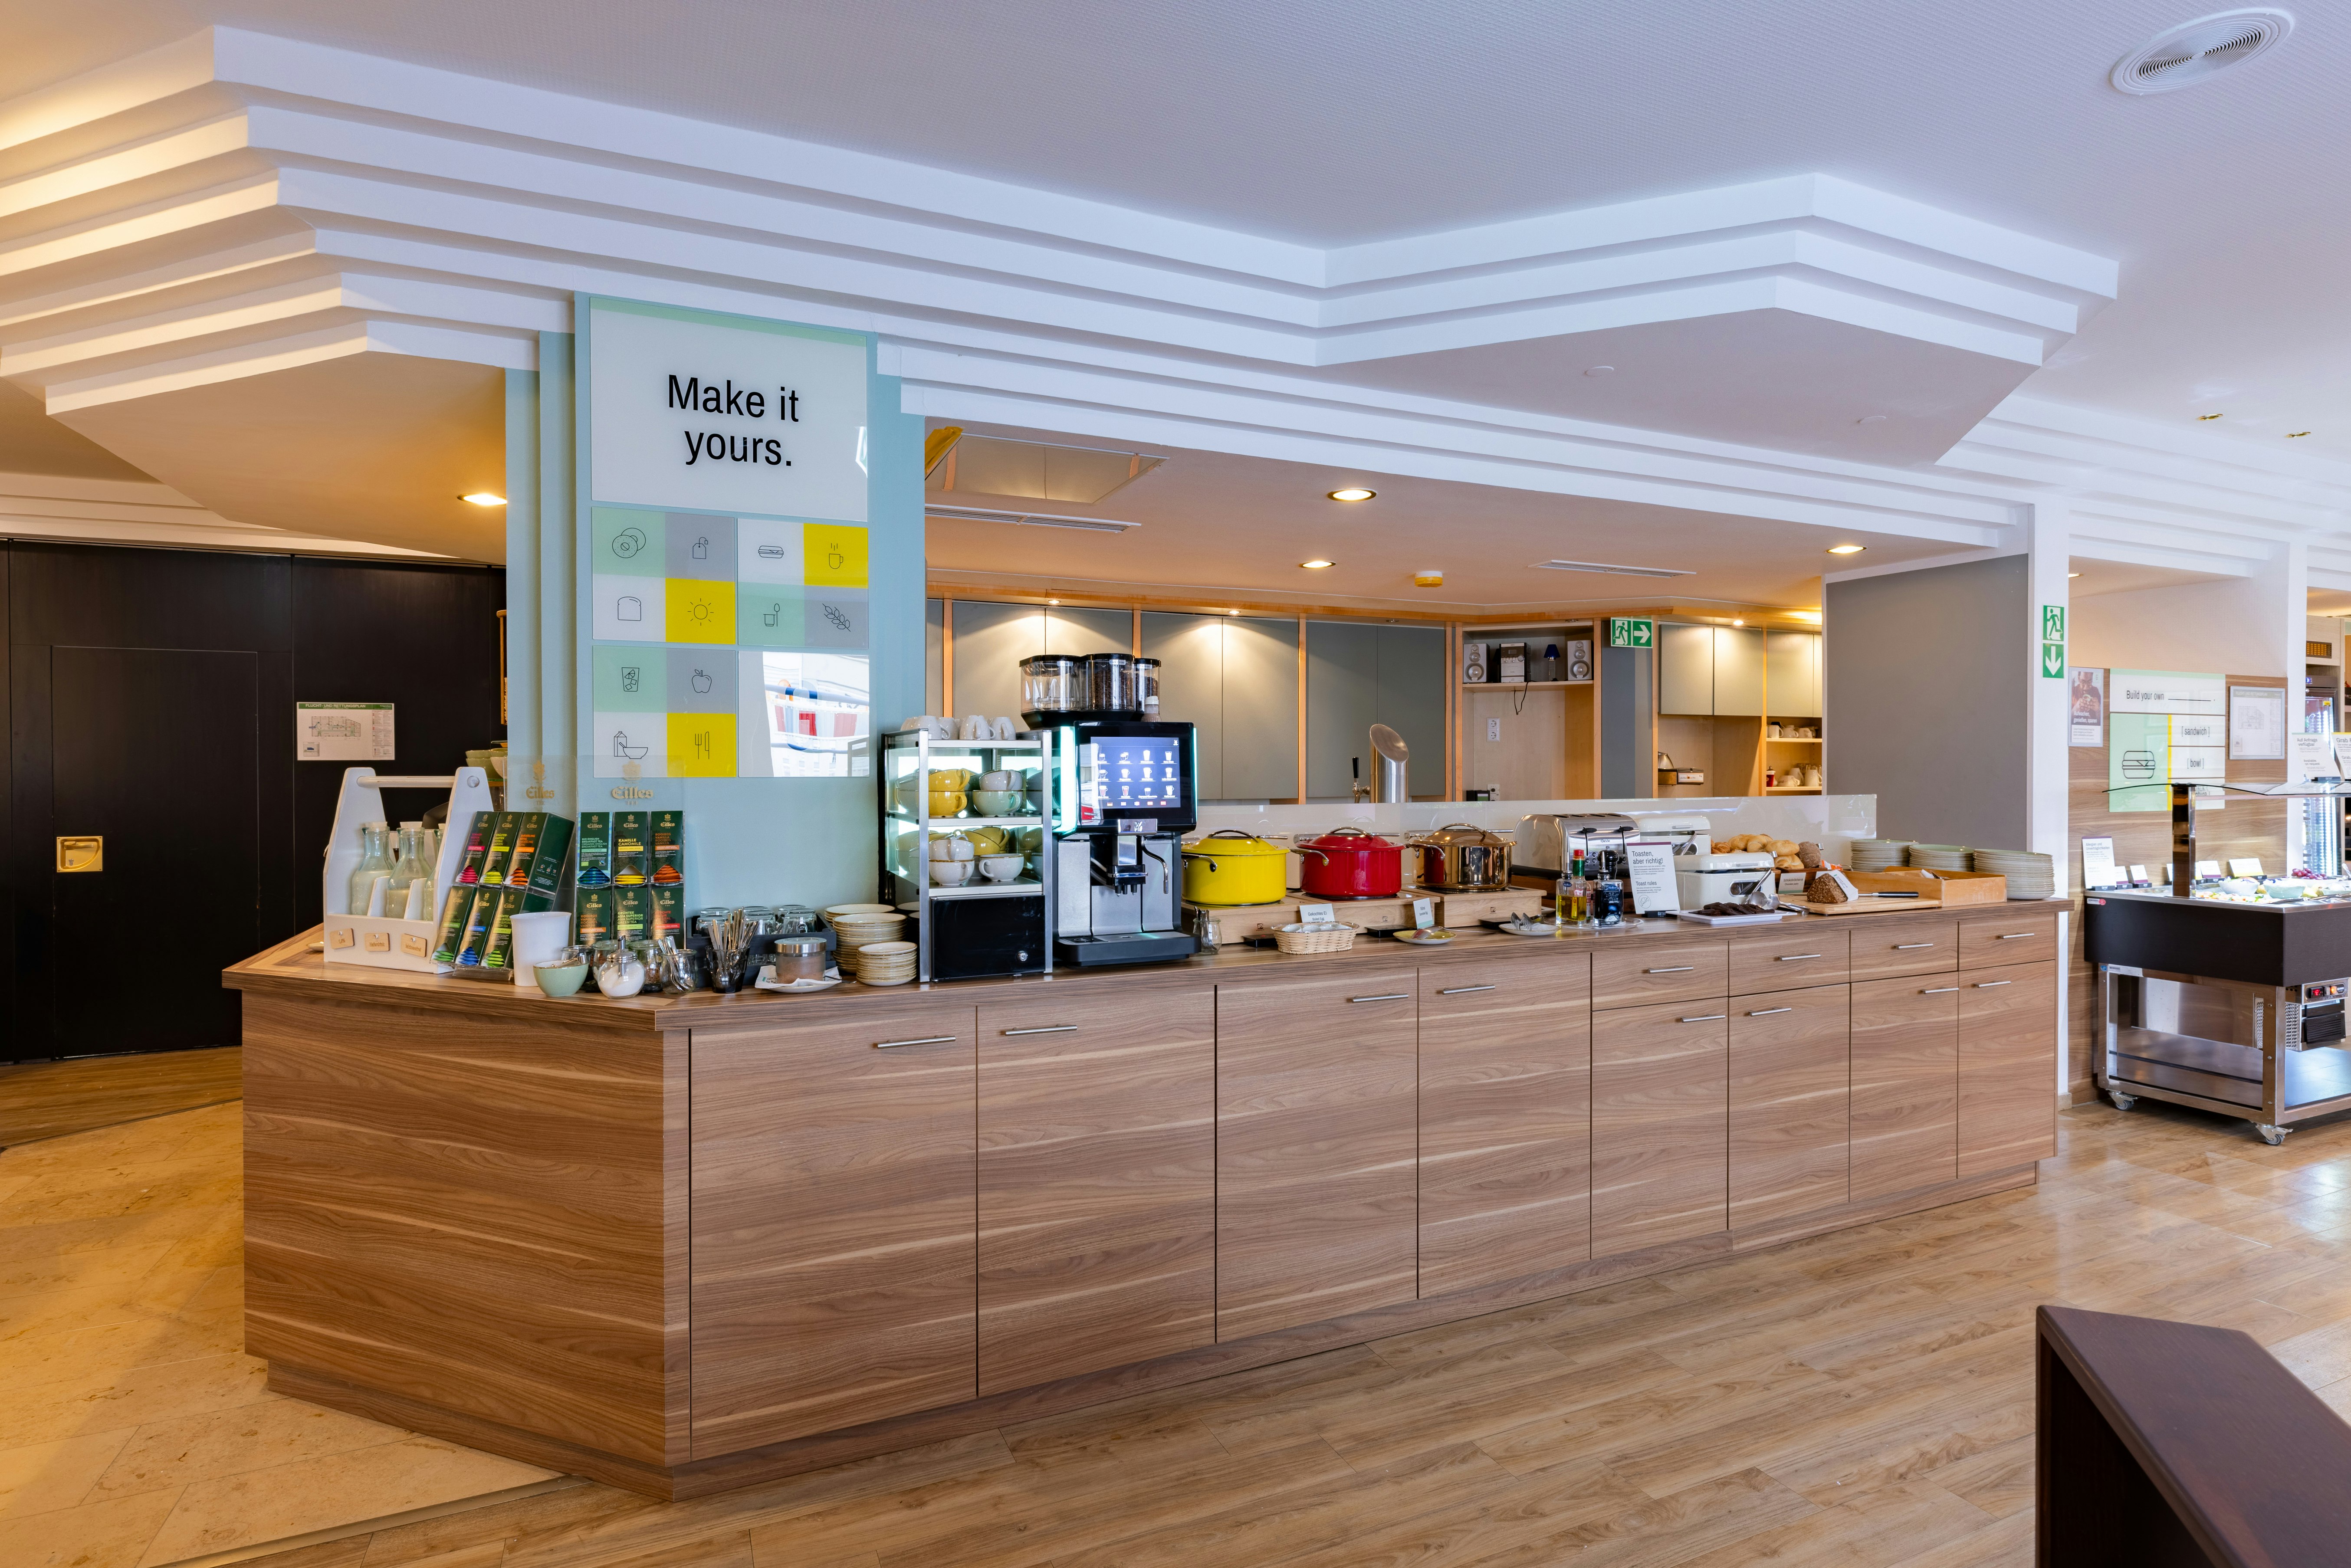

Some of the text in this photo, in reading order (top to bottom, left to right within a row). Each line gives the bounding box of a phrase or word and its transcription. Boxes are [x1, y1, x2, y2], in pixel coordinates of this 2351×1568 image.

[668, 374, 799, 422] Make it
[684, 430, 792, 466] yours.
[2126, 690, 2140, 699] Build
[2141, 692, 2152, 701] your
[2184, 727, 2207, 736] sandwich
[526, 785, 555, 799] Eilles
[612, 786, 653, 799] Eilles
